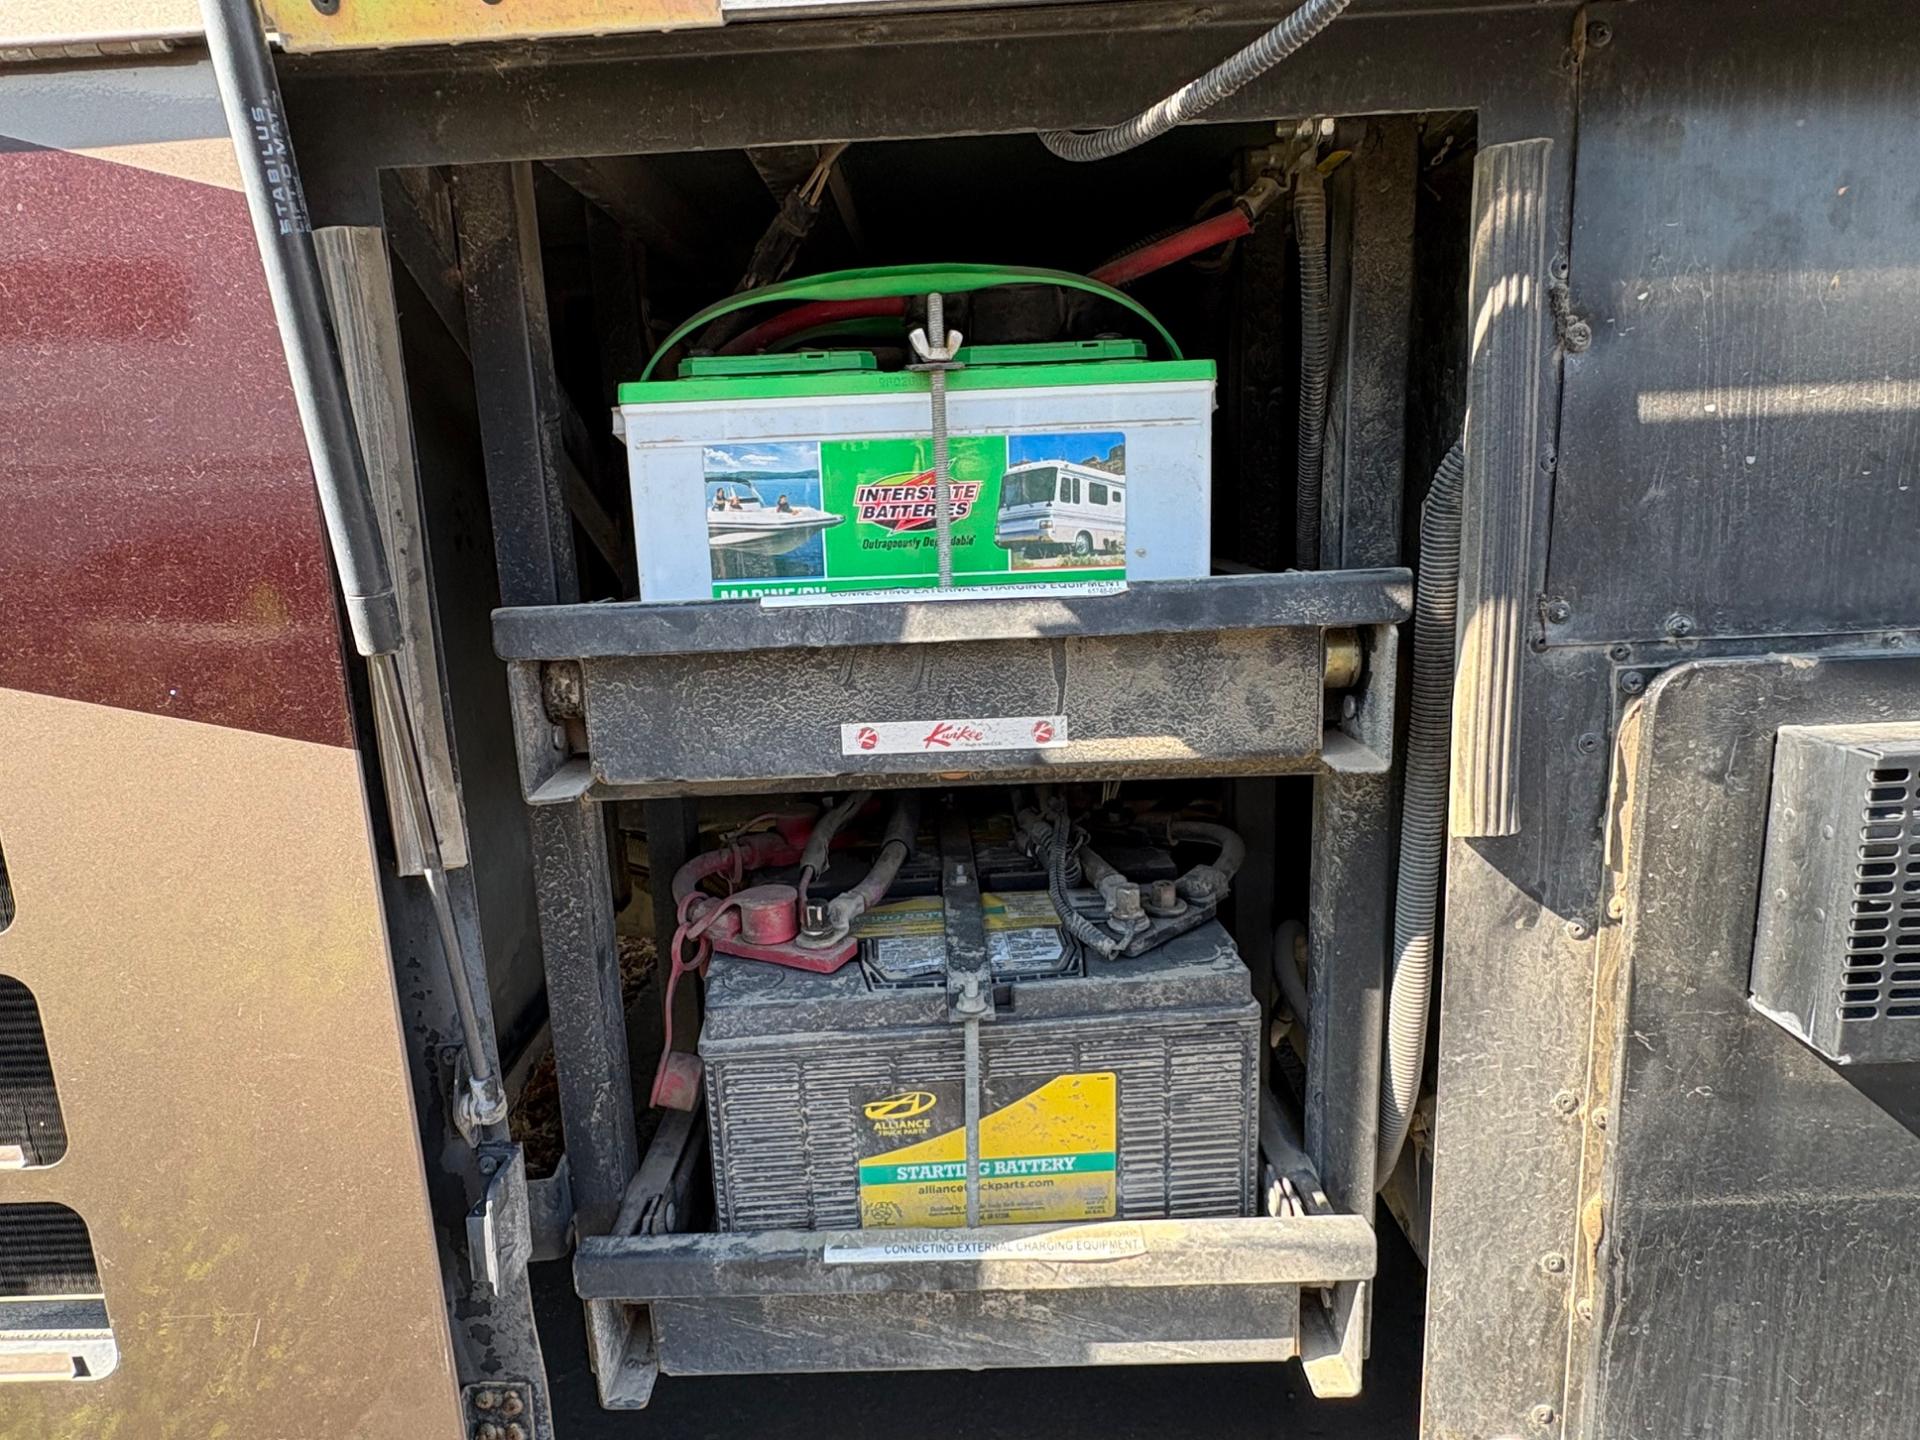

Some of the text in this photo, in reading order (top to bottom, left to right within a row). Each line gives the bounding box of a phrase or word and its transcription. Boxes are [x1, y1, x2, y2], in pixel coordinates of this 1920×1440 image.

[251, 106, 292, 235] STABILUS
[858, 485, 977, 502] INTERSTTE
[863, 502, 968, 519] BATTERES
[862, 537, 920, 551] Outrageously
[873, 1119, 931, 1131] ALLIANCE
[897, 1156, 1077, 1181] STARTIG BATTERY
[884, 1243, 954, 1254] CONNECTING
[957, 1241, 1013, 1253] EXTERNAL
[1016, 1239, 1073, 1251] CHARGING
